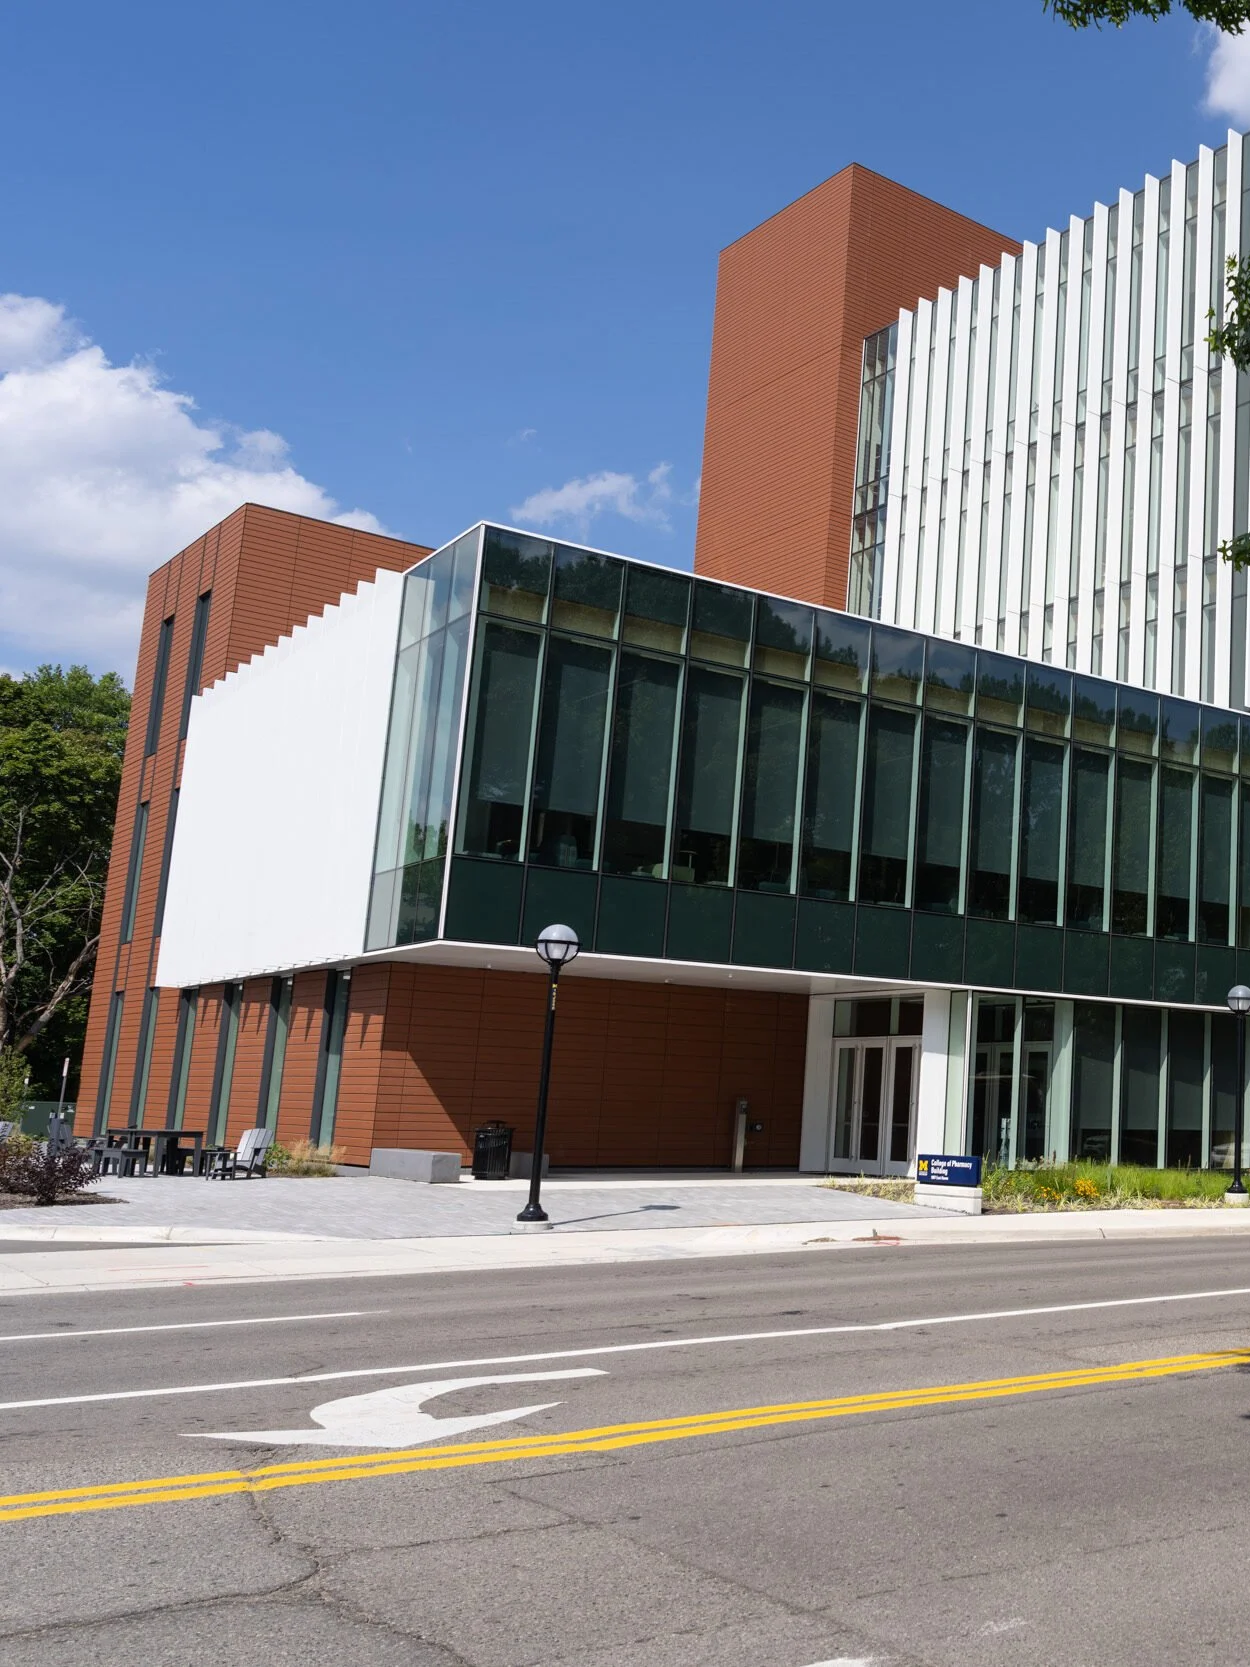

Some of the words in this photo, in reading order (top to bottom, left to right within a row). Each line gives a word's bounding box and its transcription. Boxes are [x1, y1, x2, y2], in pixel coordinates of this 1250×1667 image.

[919, 1160, 929, 1171] M
[931, 1159, 947, 1169] College
[952, 1160, 973, 1170] Pharmacy
[931, 1167, 948, 1176] Building
